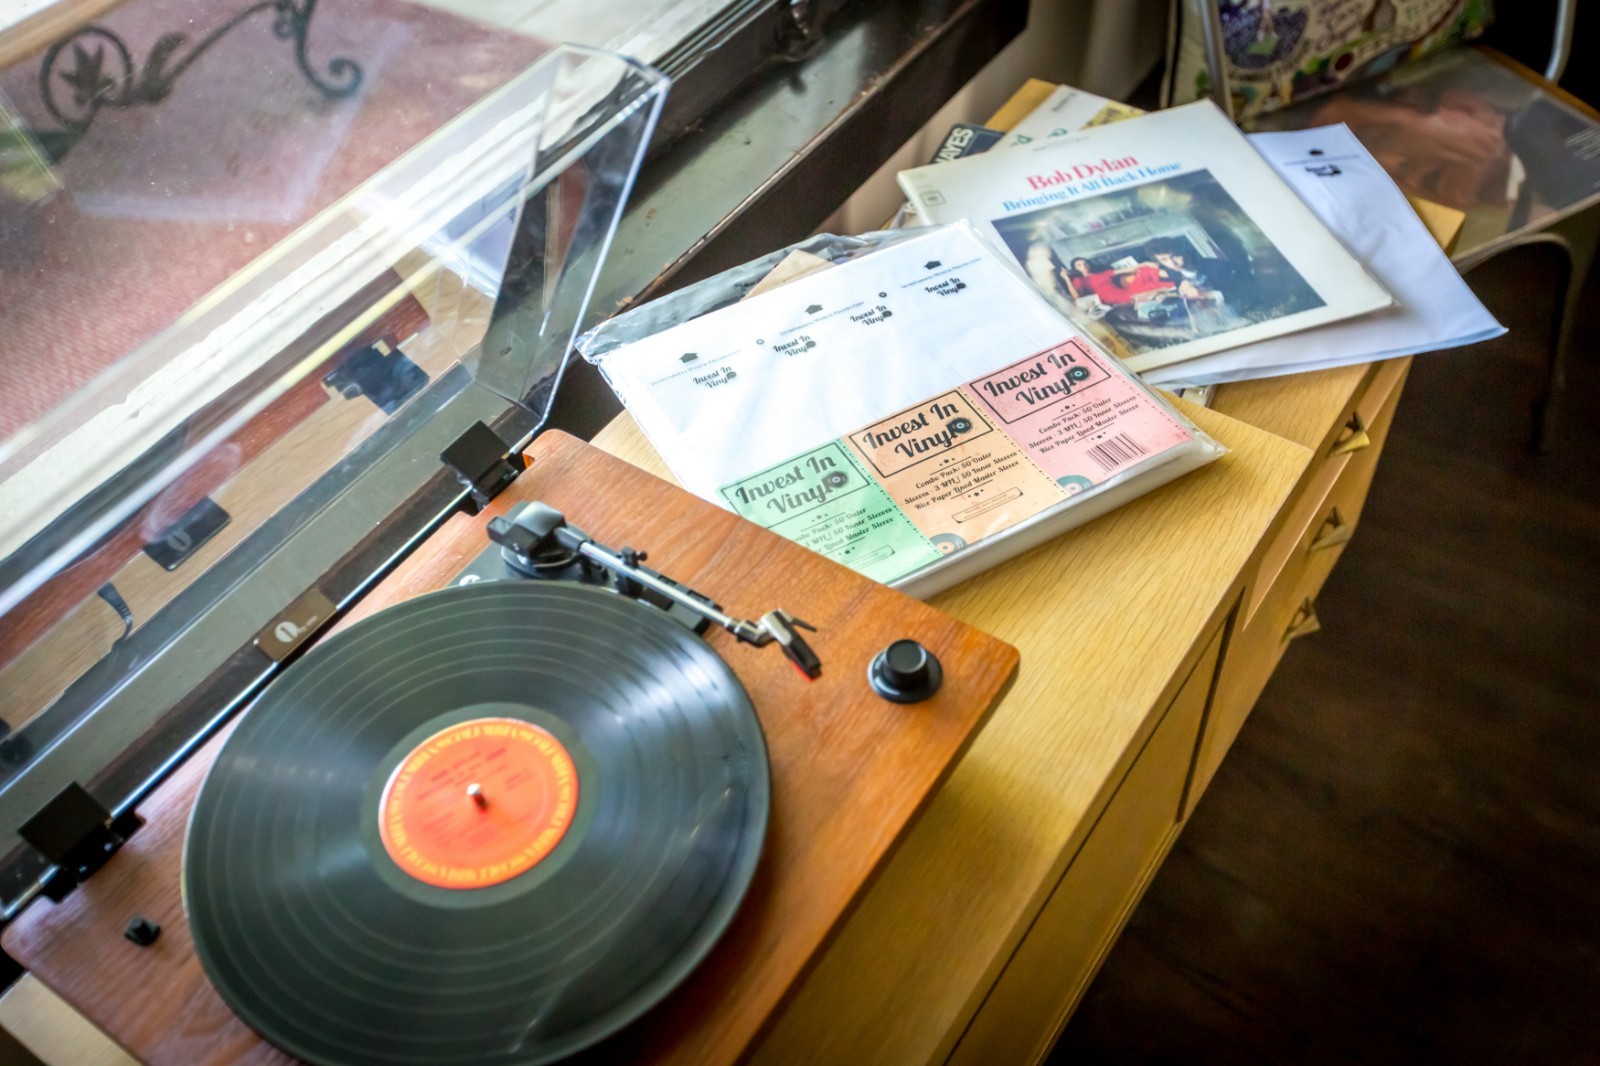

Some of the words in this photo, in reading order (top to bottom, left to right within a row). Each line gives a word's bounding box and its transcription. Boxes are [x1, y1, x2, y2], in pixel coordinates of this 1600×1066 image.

[1002, 189, 1066, 212] Bringing
[1066, 185, 1079, 196] It
[1081, 181, 1102, 192] All
[1101, 170, 1137, 189] Back
[1137, 162, 1182, 179] Home
[1026, 170, 1073, 191] Bob
[1072, 155, 1140, 180] Dylan
[924, 280, 949, 293] Invest
[949, 277, 960, 285] In
[850, 308, 875, 323] Invest
[876, 304, 887, 312] In
[772, 338, 799, 352] Invest
[692, 369, 720, 385] Invest
[720, 365, 732, 374] In
[983, 361, 1048, 397] Invest
[1047, 352, 1076, 369] In
[1015, 371, 1078, 405] Vinyl
[863, 412, 929, 449] Invest
[930, 402, 959, 421] In
[1028, 435, 1053, 449] Sleeves
[1083, 415, 1093, 424] 50
[1093, 407, 1112, 419] Inner
[1113, 396, 1136, 409] Sleeves
[1038, 421, 1061, 434] Combo
[1082, 406, 1092, 414] 50
[1092, 397, 1111, 409] Outer
[1039, 445, 1054, 454] Rice
[1055, 435, 1075, 447] Paper
[1076, 425, 1095, 437] Lined
[1094, 414, 1117, 428] Master
[1119, 403, 1139, 416] Sleeve
[894, 424, 959, 458] Vinyl
[735, 465, 805, 504] Invest
[806, 455, 837, 474] In
[904, 491, 930, 505] Sleeves
[961, 471, 972, 479] 50
[972, 463, 991, 475] Inner
[993, 452, 1017, 465] Sleeves
[914, 501, 930, 510] Rice
[930, 491, 952, 504] Paper
[952, 480, 972, 493] Lined
[973, 470, 997, 484] Master
[997, 460, 1020, 473] Sleeve
[915, 476, 939, 489] Combo
[961, 461, 971, 469] 50
[972, 452, 992, 464] Outer
[766, 479, 834, 514] Vinyl
[833, 528, 844, 536] 50
[844, 519, 865, 531] Inner
[867, 507, 893, 521] Sleeves
[834, 516, 845, 525] 50
[845, 507, 867, 520] Outer
[845, 527, 870, 541] Master
[871, 517, 894, 530] Sleeve
